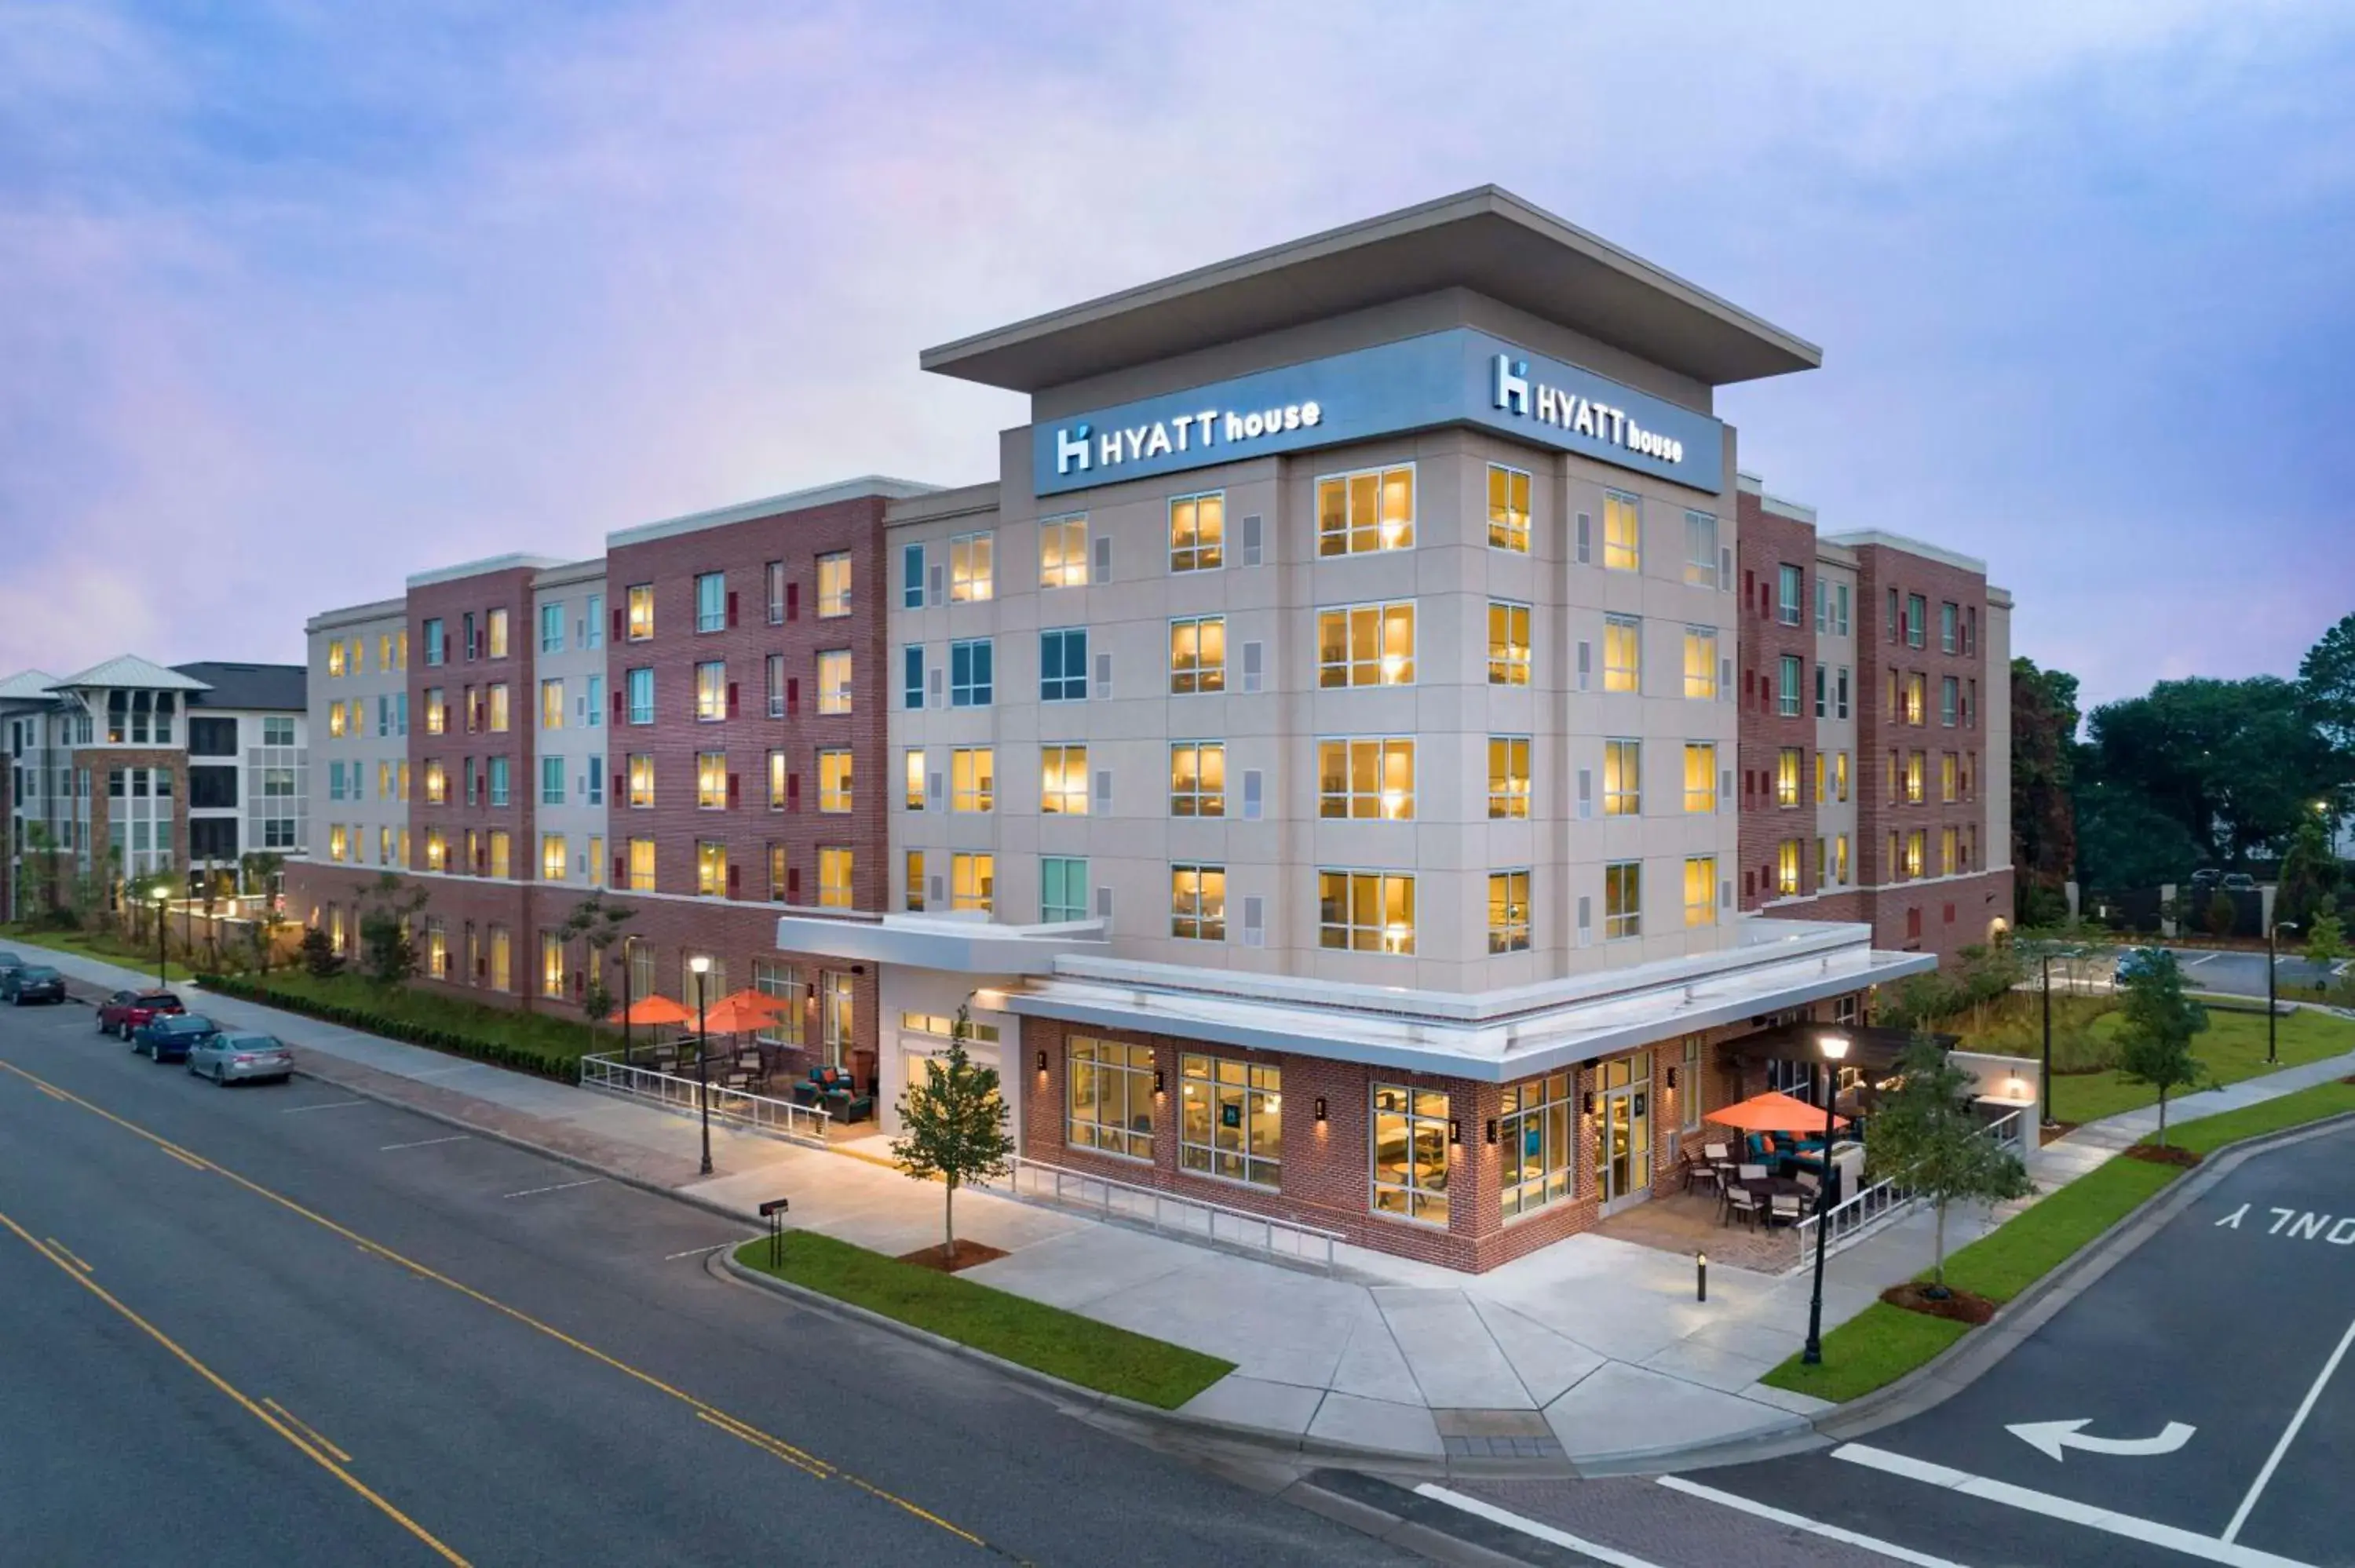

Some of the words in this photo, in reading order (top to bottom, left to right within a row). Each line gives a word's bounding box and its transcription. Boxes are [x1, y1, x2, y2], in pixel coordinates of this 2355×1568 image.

[1101, 409, 1218, 466] HYATT
[1225, 400, 1322, 443] house
[1536, 383, 1625, 445] HYATT
[1627, 418, 1684, 465] house
